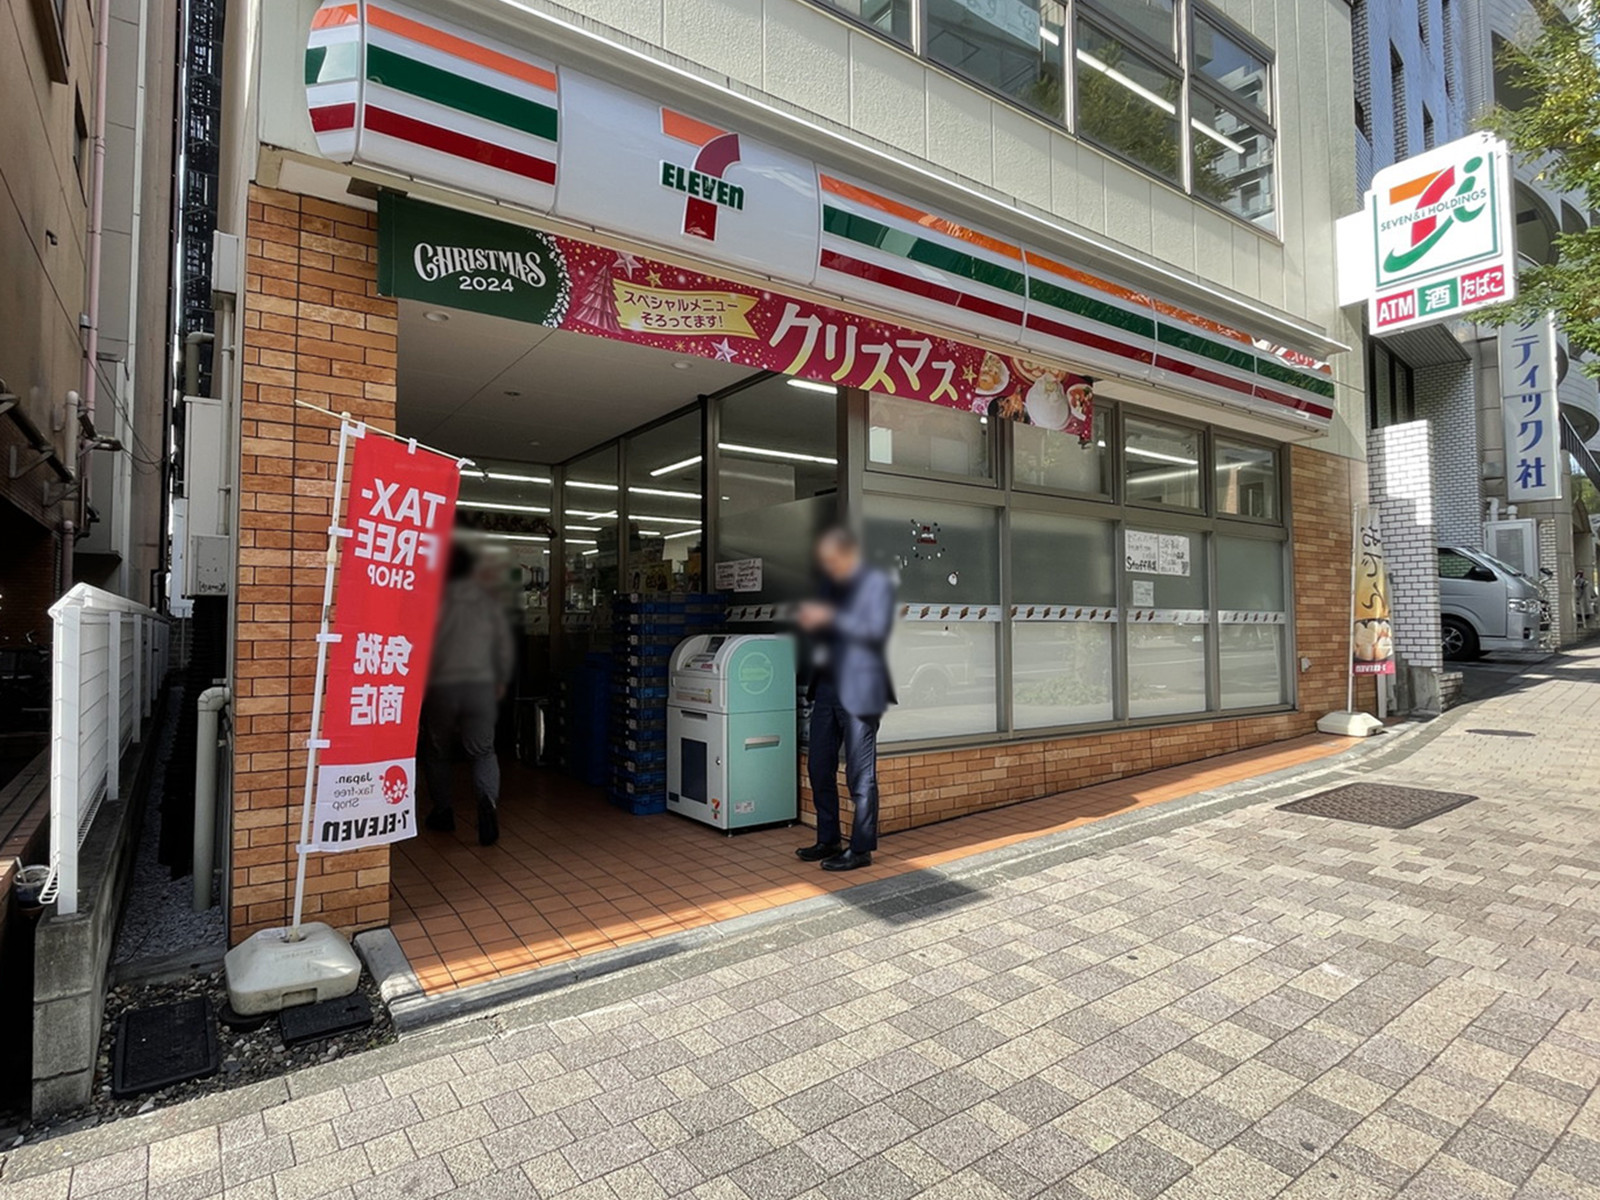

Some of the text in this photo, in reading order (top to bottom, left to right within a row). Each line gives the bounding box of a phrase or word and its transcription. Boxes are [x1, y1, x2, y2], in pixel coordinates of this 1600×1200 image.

[1427, 188, 1487, 216] HOLDINGS
[414, 243, 546, 288] CHRISTMAS
[459, 276, 514, 292] 2024
[1425, 284, 1450, 312] 酒
[1462, 272, 1503, 300] たばこ
[623, 290, 738, 313] スペシャルメニュー
[1379, 295, 1413, 322] ATM
[641, 311, 723, 328] そろってます!
[769, 302, 959, 402] クリスマス
